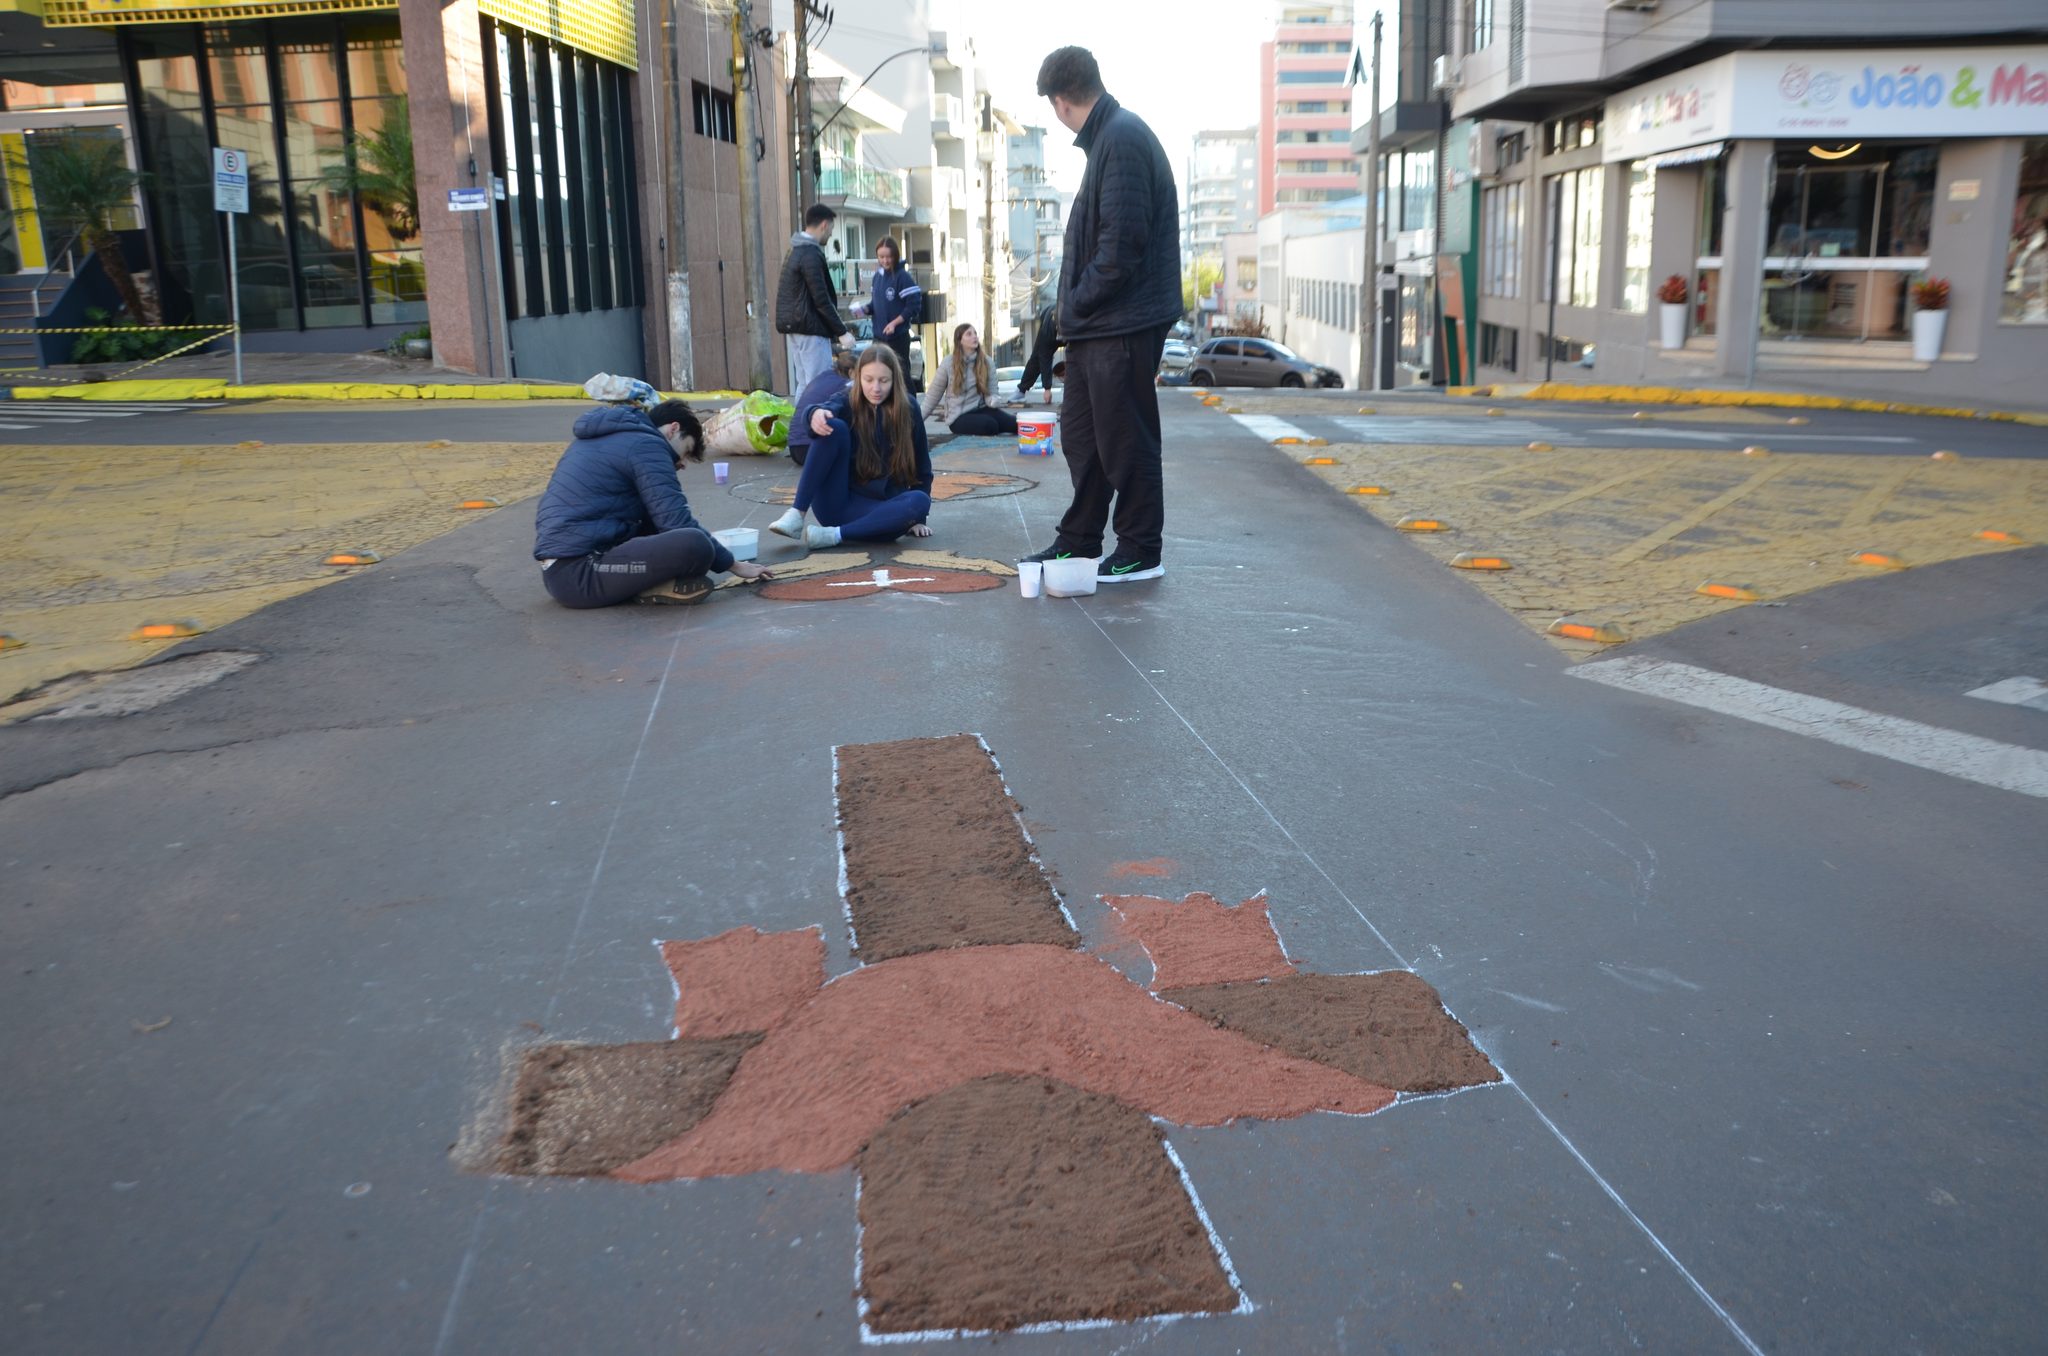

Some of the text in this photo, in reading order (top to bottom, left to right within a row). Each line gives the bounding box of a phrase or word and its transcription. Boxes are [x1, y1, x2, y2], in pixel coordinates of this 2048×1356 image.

[1851, 62, 2048, 108] João & Ma
